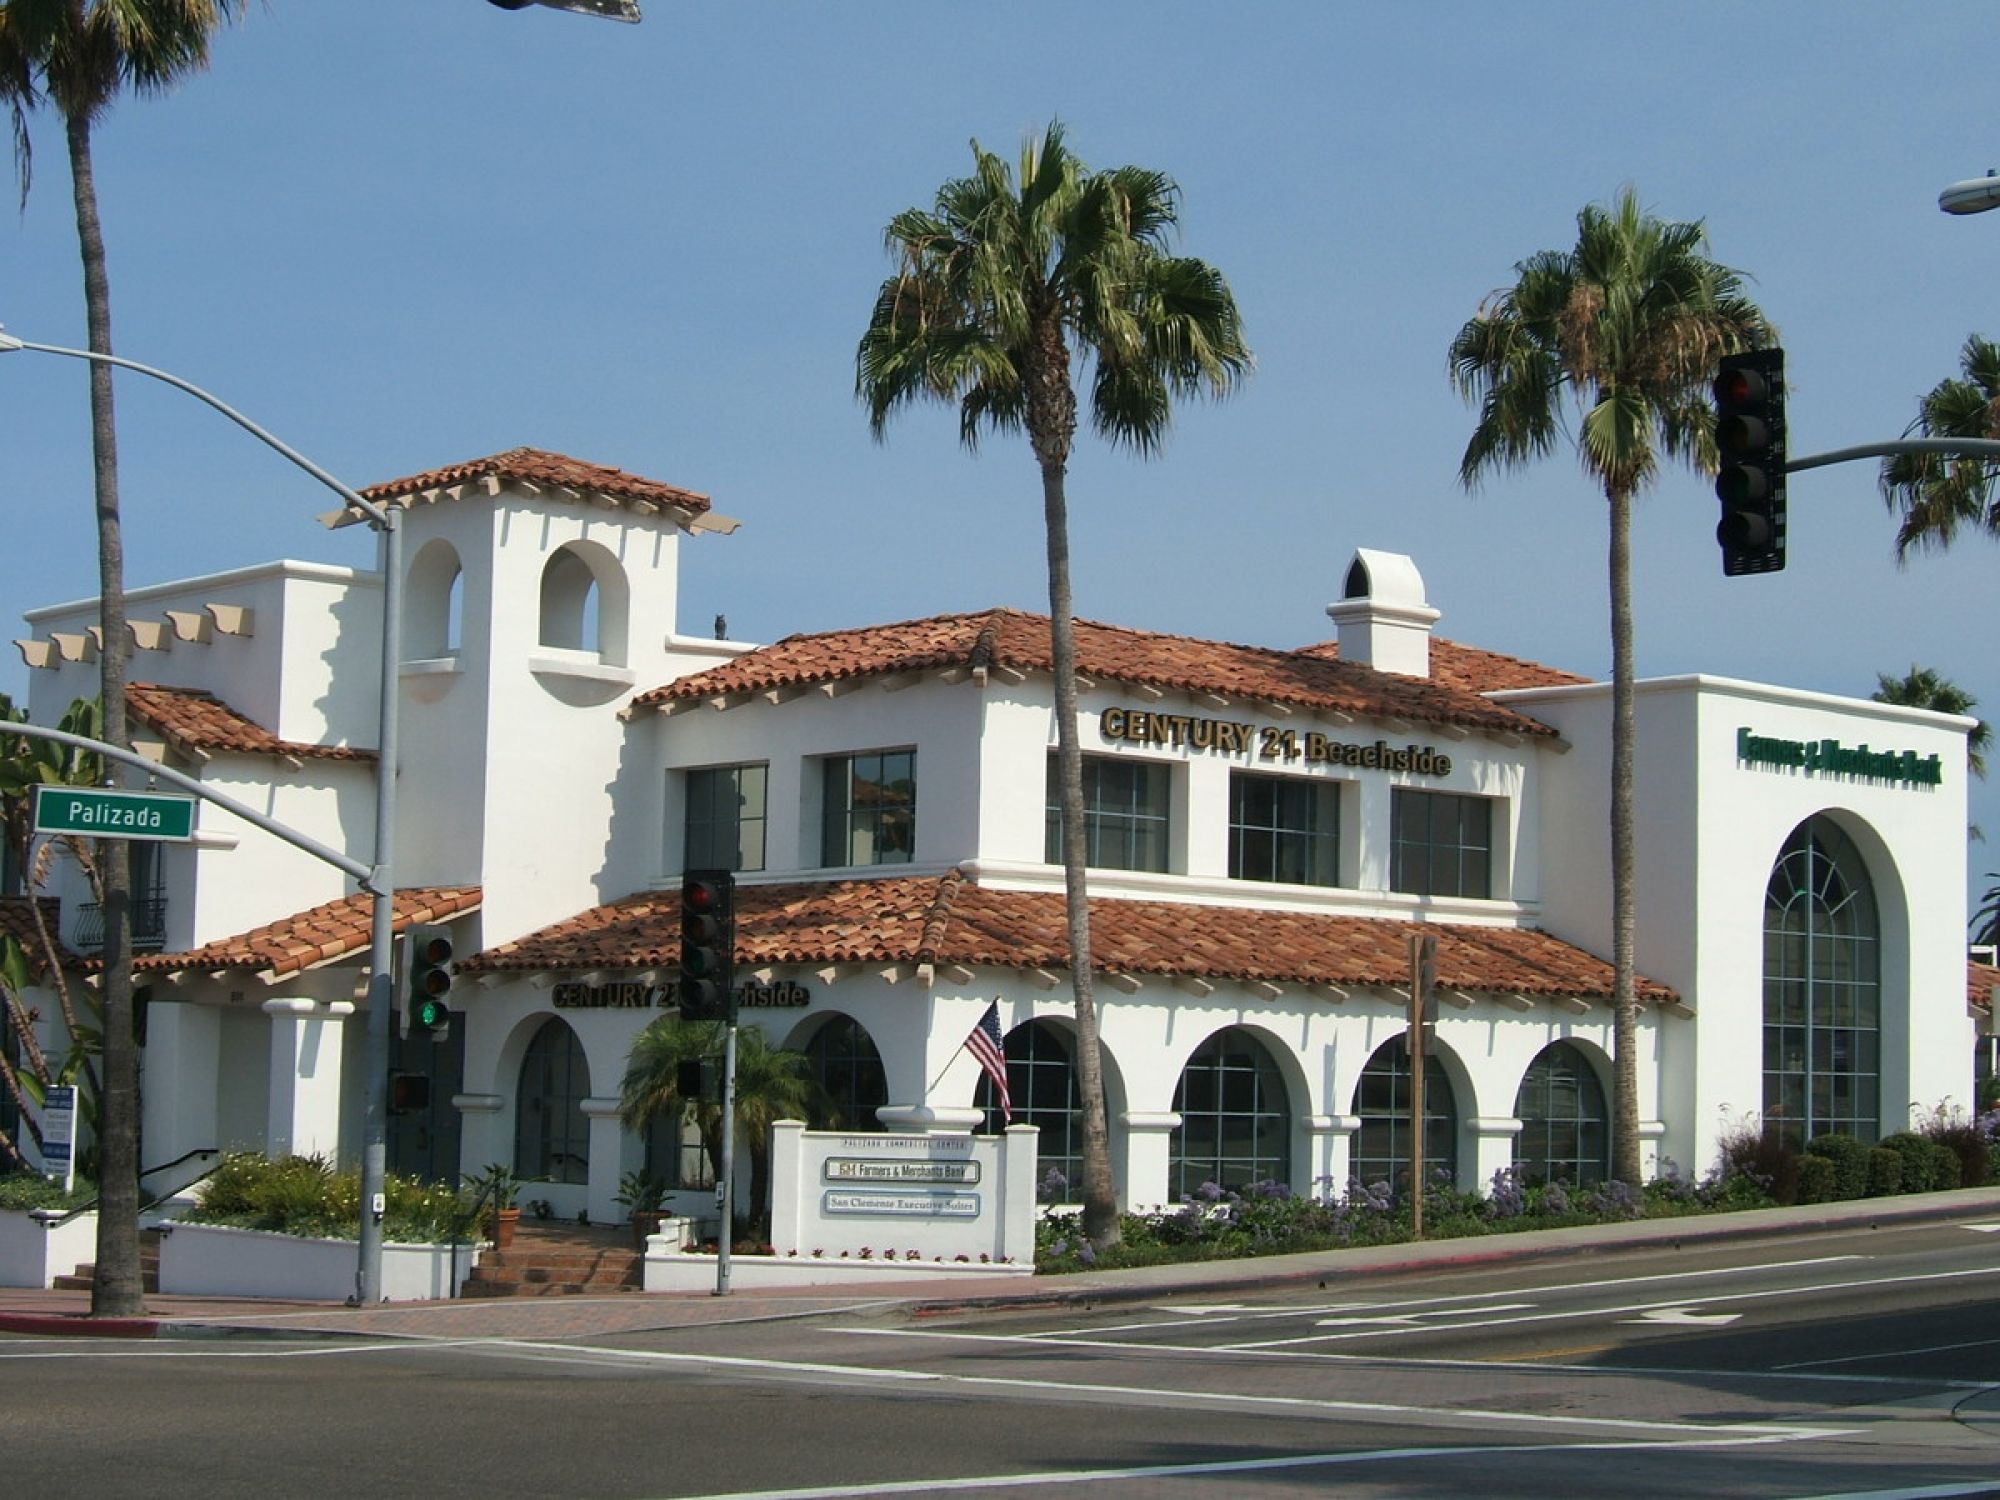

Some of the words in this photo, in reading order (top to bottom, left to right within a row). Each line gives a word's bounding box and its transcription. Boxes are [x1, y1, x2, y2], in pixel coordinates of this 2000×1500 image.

[1101, 707, 1254, 752] CENTURY
[1305, 731, 1452, 776] Beachside
[69, 801, 161, 828] Palizada
[552, 982, 654, 1008] CENTURY
[859, 1164, 891, 1177] Farmers
[901, 1164, 943, 1178] Merchants
[944, 1165, 965, 1178] Bank
[831, 1196, 848, 1207] San
[851, 1197, 895, 1208] Clemente
[898, 1199, 942, 1209] Executive
[944, 1199, 973, 1210] Suites
